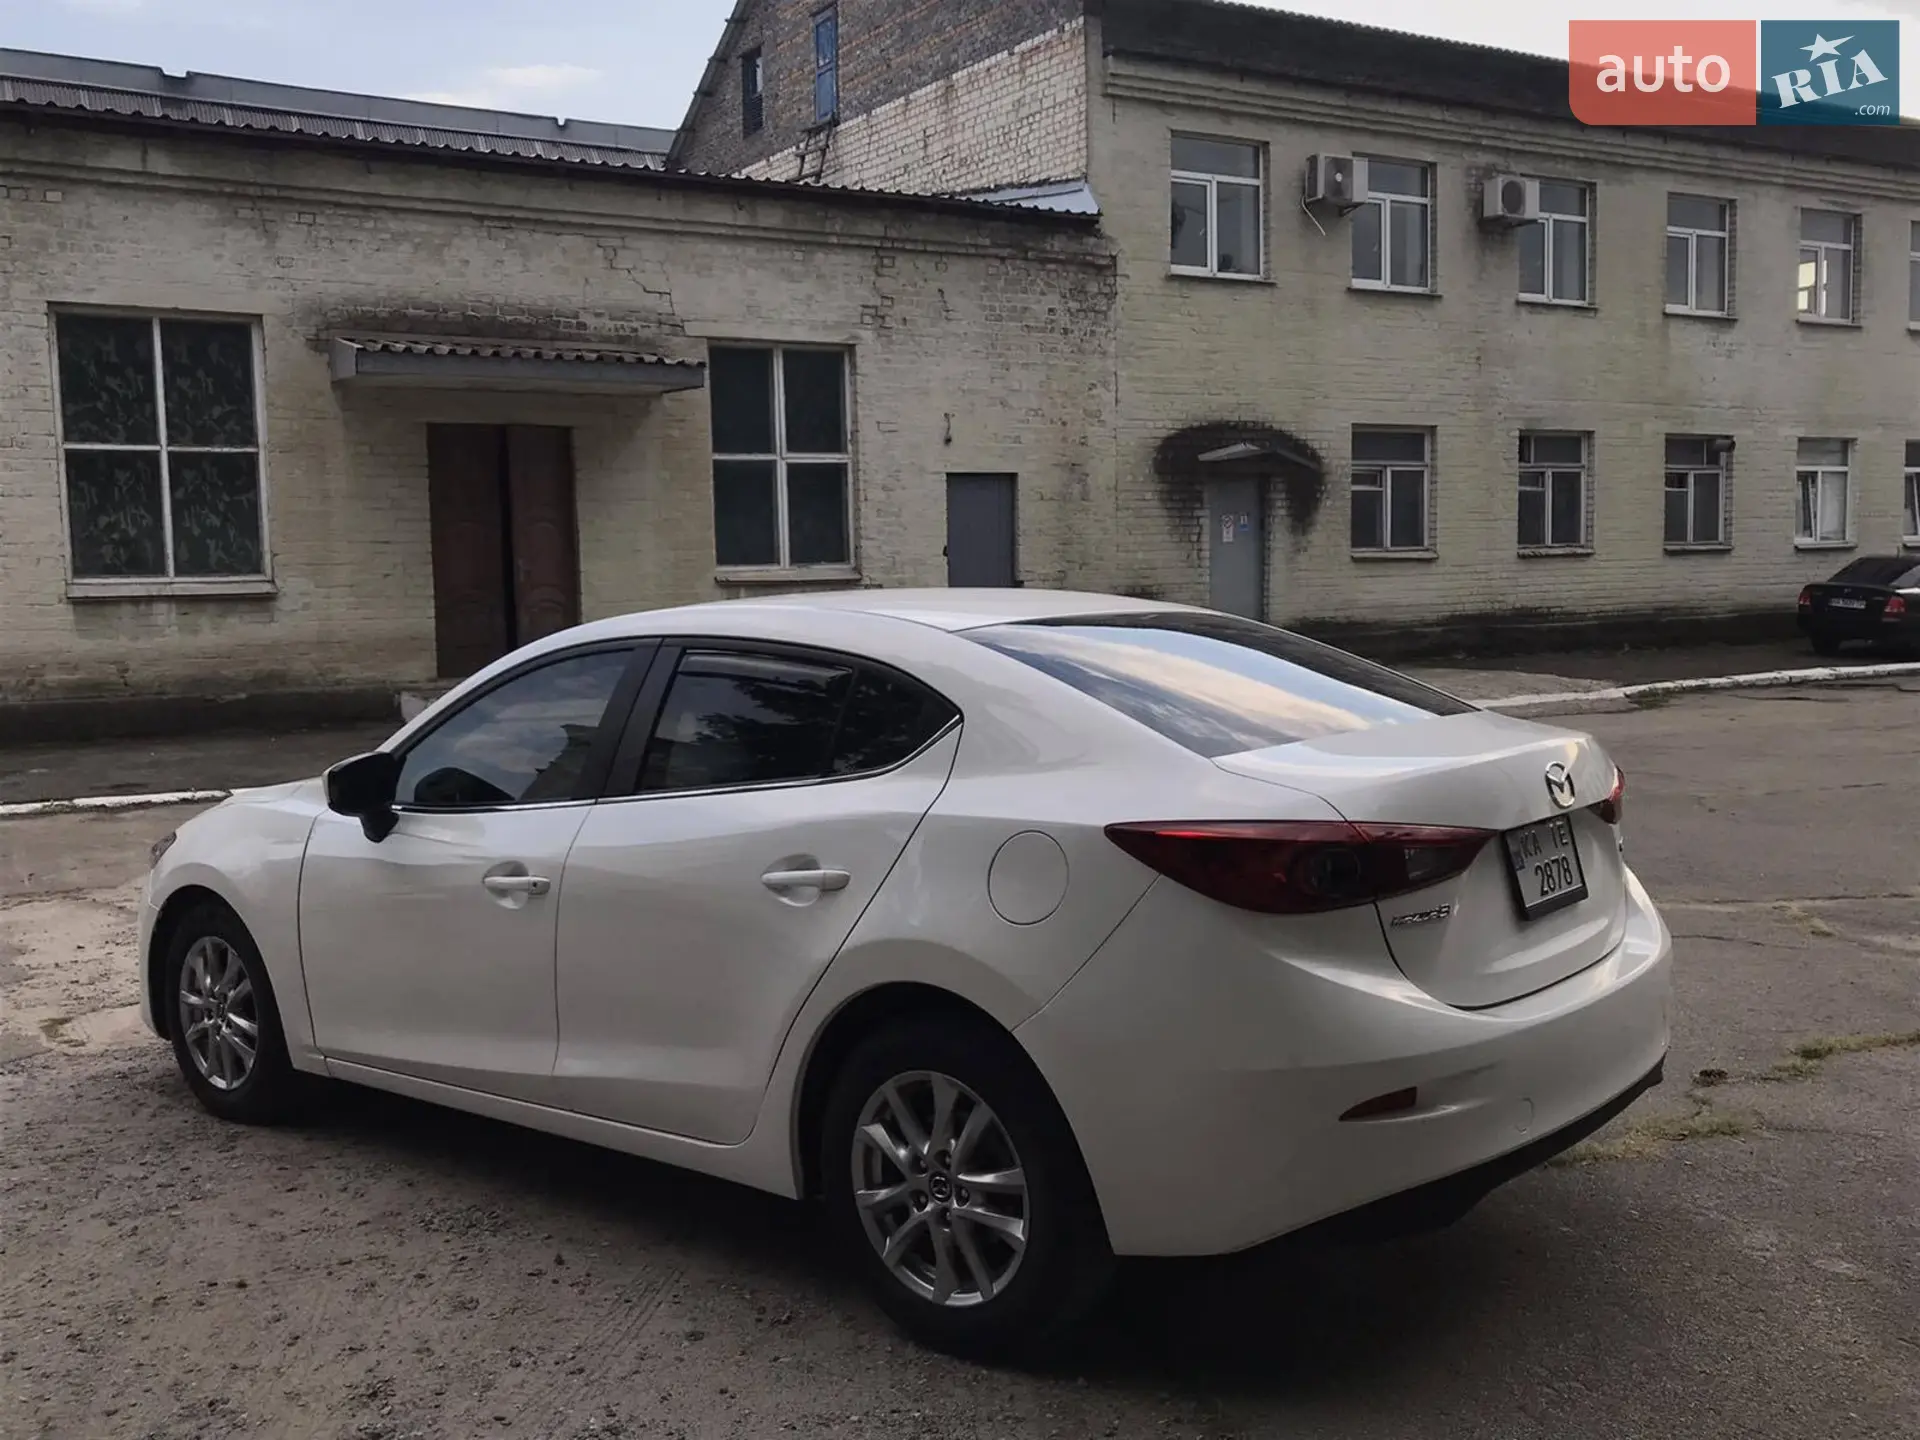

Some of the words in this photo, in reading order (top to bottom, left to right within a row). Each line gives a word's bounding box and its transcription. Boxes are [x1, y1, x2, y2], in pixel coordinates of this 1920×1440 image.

[1520, 831, 1542, 859] KA
[1548, 821, 1569, 848] TE
[1534, 855, 1573, 896] 2878
